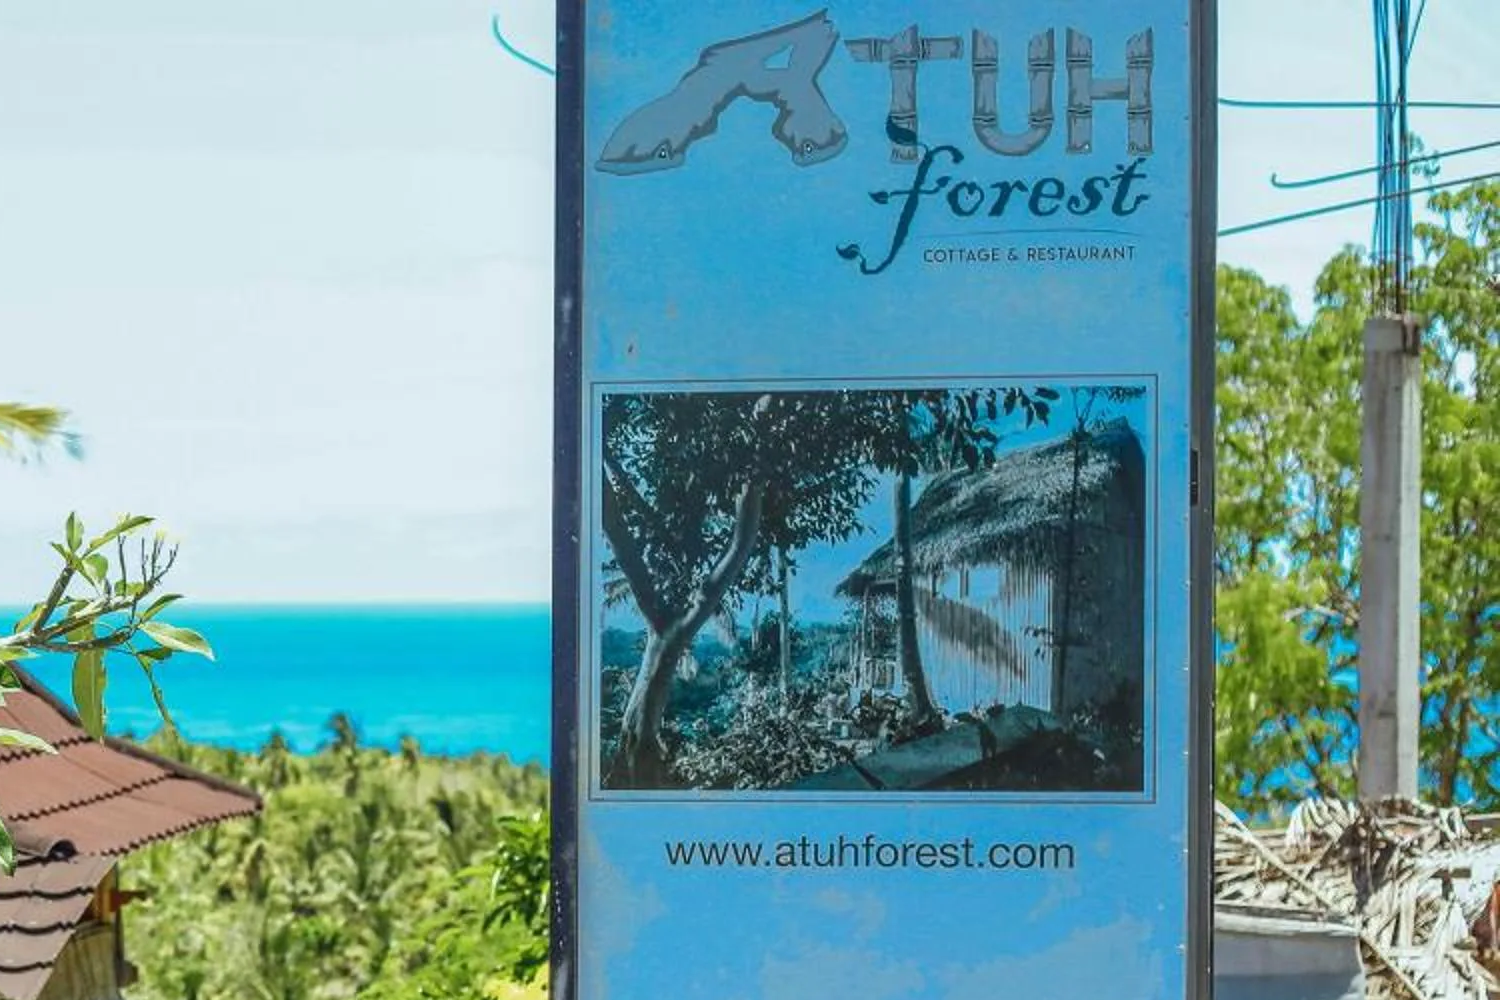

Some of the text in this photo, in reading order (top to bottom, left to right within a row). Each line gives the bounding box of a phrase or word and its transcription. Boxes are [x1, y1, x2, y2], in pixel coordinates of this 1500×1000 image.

[594, 8, 1153, 176] ATUH
[836, 142, 1152, 275] forest
[922, 245, 1137, 264] COTTAGE & RESTAURANT
[664, 833, 1076, 870] www.atuhforest.com
